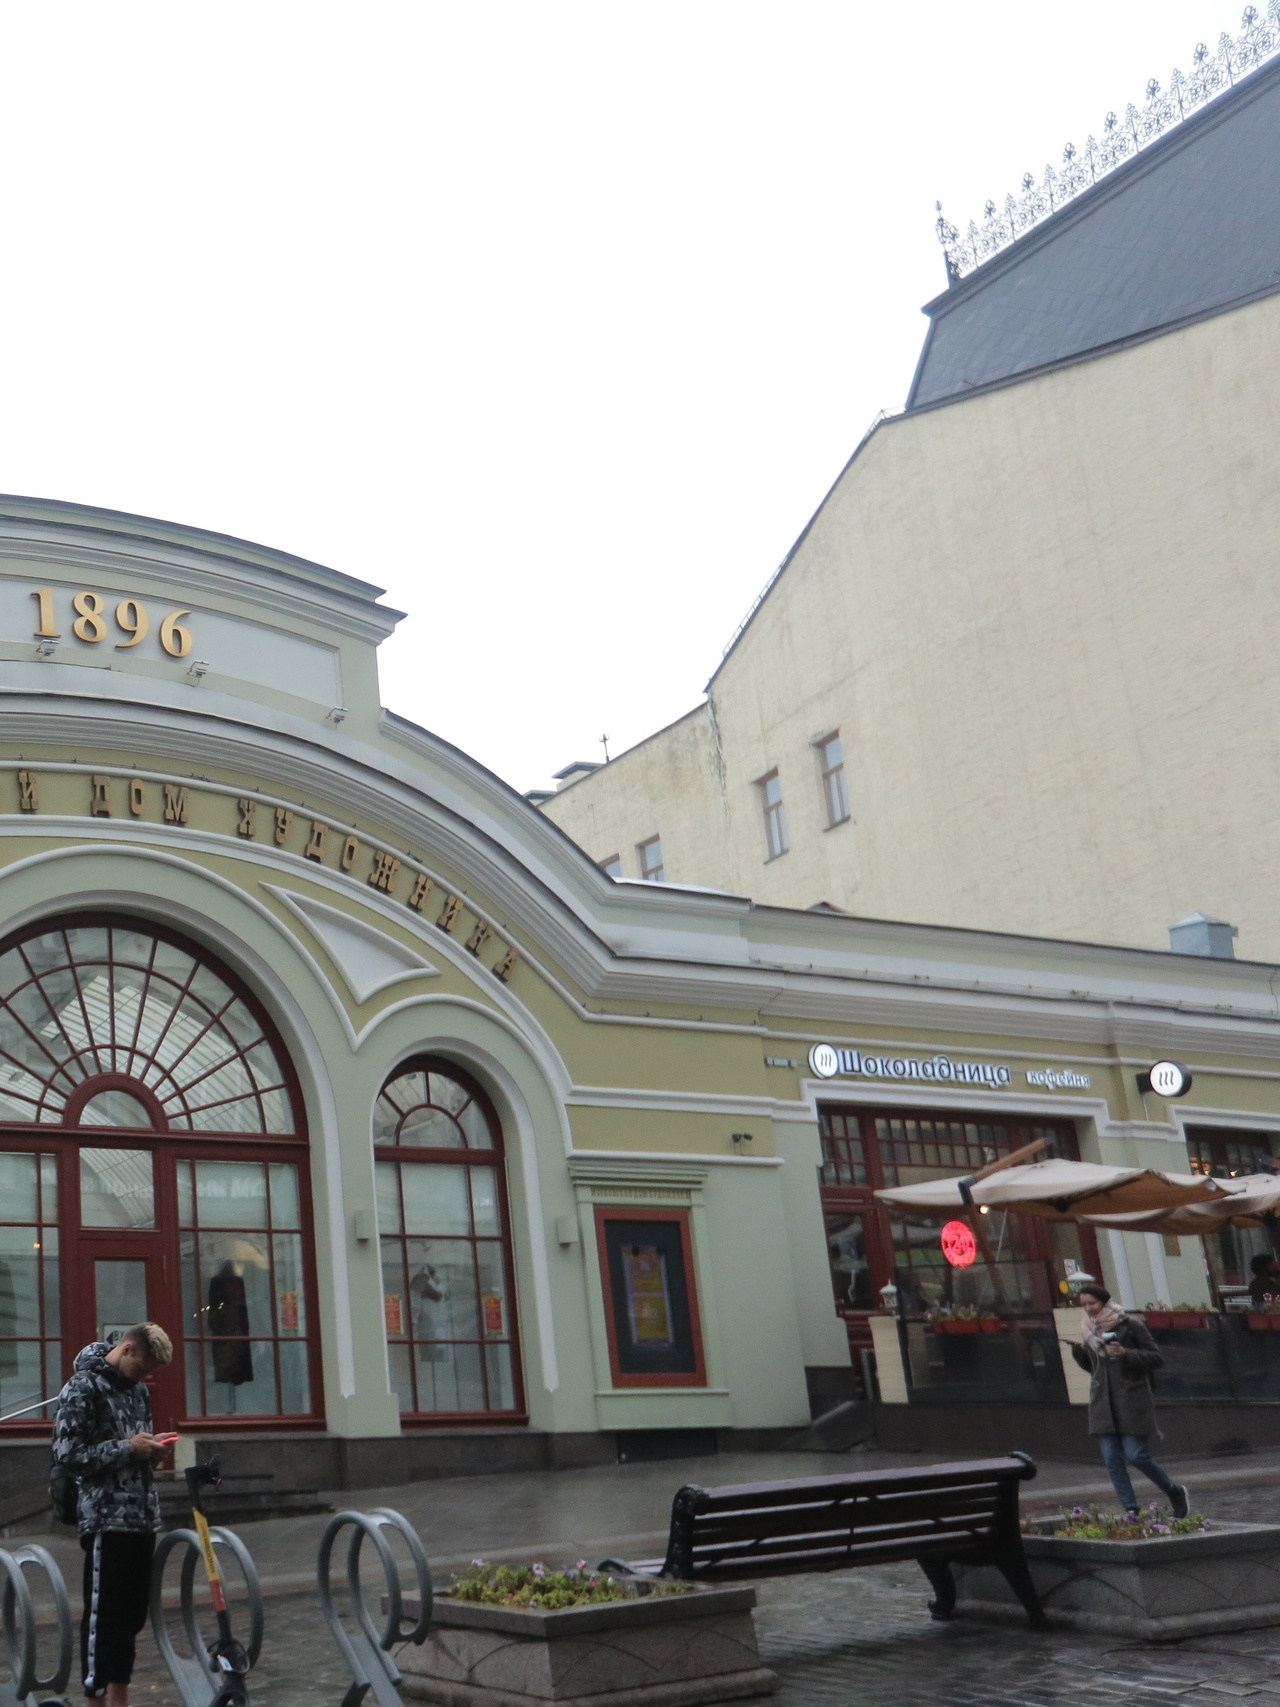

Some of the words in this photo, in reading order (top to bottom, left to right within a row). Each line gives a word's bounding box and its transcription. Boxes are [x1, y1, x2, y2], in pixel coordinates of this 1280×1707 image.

[30, 581, 193, 658] 1896
[91, 774, 189, 825] ДОМ
[238, 798, 519, 983] ХУДОЖНИКА
[838, 1049, 1012, 1089] Шоколадница
[1025, 1067, 1091, 1091] кофейня
